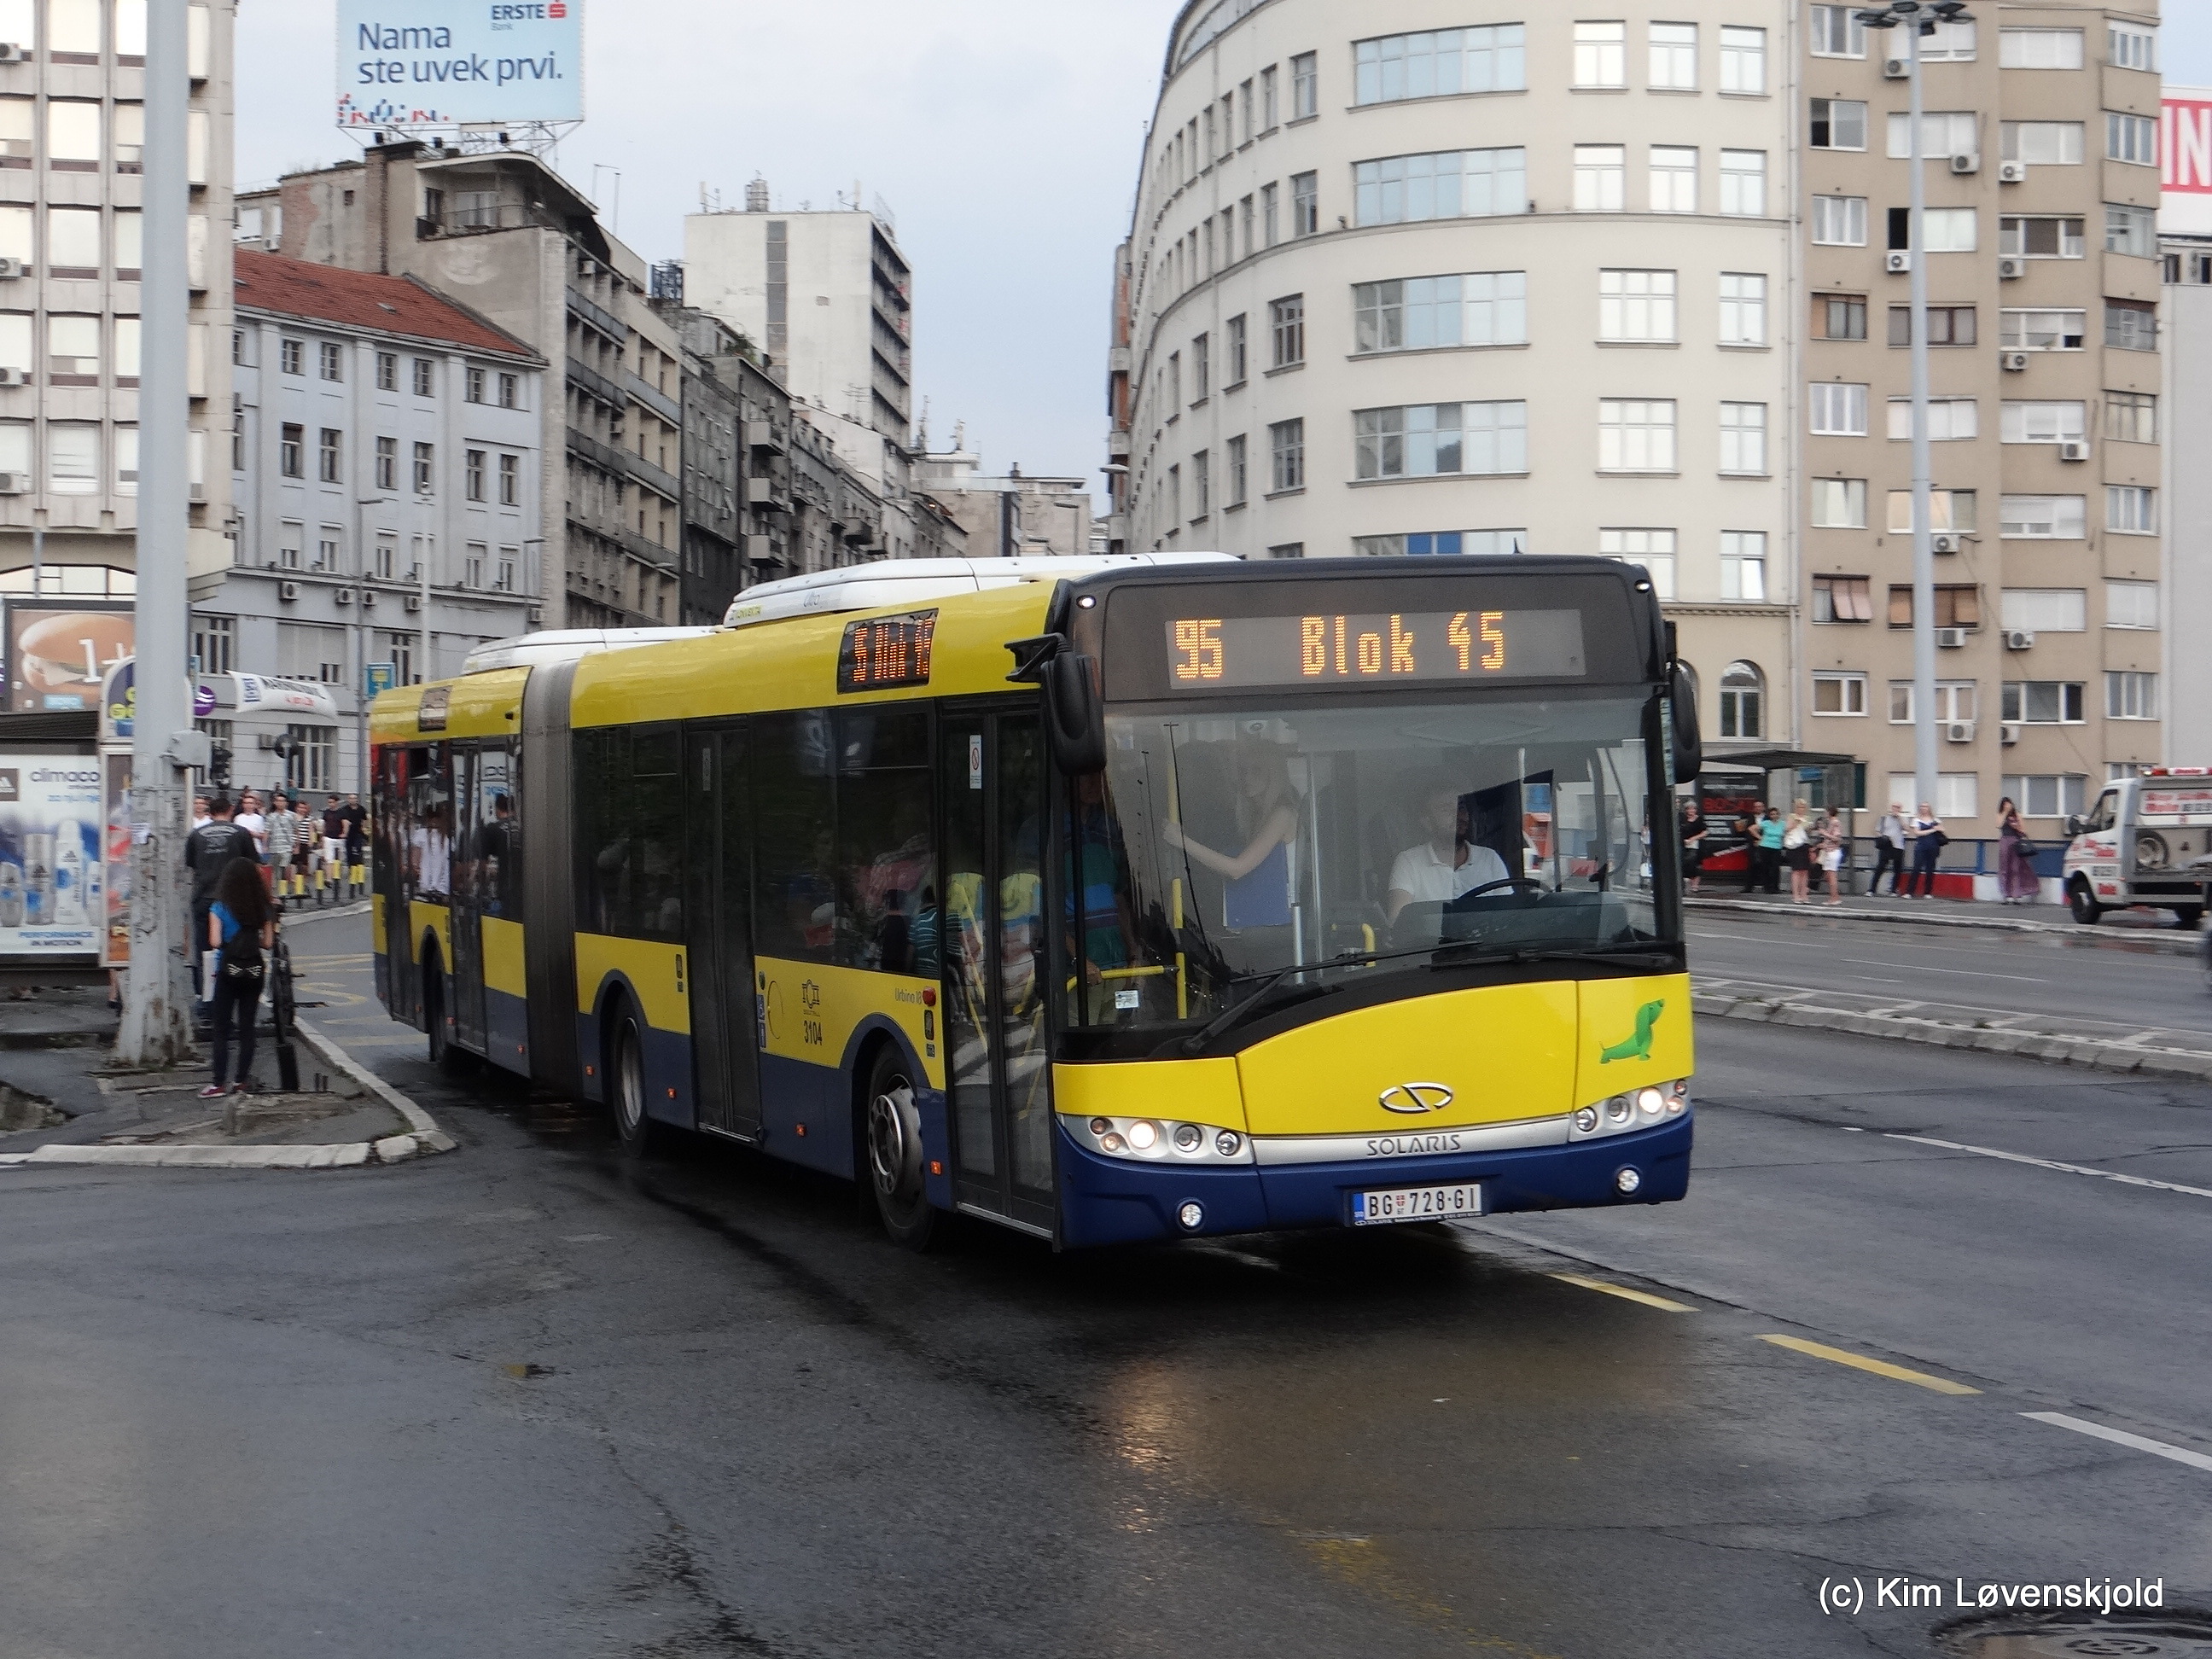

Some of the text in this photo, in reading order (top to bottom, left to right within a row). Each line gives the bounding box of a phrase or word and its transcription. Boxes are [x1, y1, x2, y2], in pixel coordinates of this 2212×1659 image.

[491, 4, 545, 20] ERSTE
[358, 22, 451, 50] Nama
[358, 50, 563, 86] ste uvek prvi.
[1175, 611, 1505, 679] 95 Blok 45
[894, 987, 923, 1005] Urbino 18
[803, 1020, 824, 1046] 3104
[1366, 1134, 1461, 1156] SOLARIS
[1368, 1194, 1393, 1217] BG
